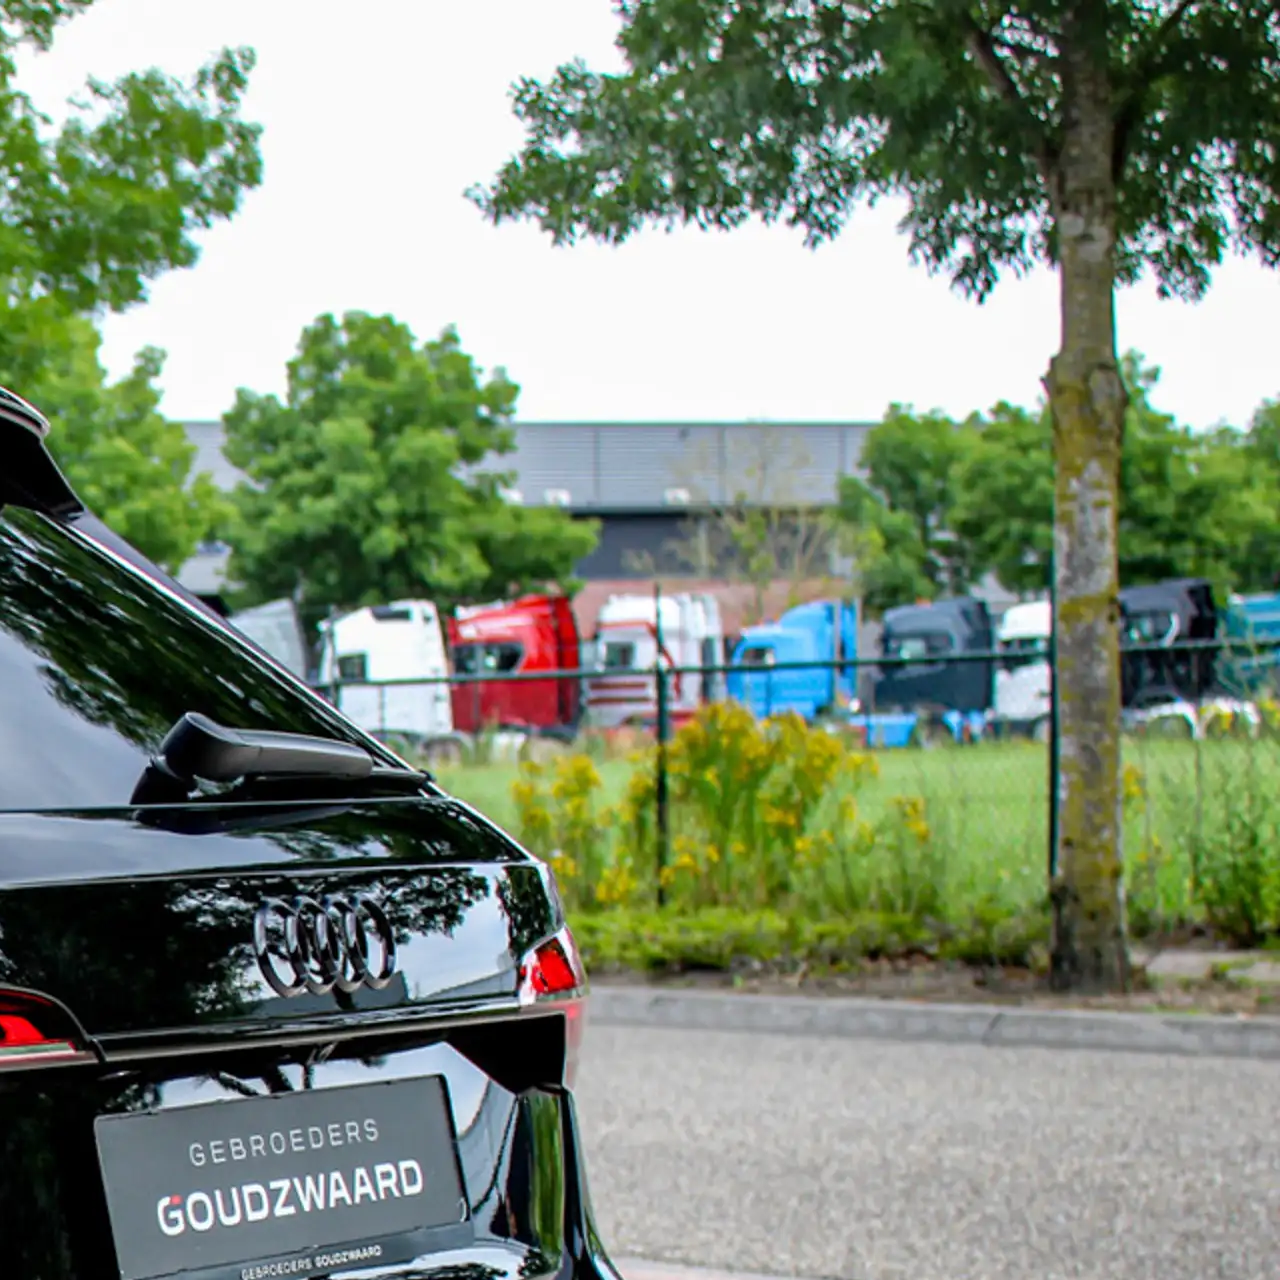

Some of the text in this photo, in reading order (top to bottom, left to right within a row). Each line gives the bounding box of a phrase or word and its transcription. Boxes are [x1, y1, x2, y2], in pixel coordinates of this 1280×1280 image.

[188, 1118, 380, 1167] GEBROEDERS
[156, 1158, 425, 1237] GOUDZWAARD
[315, 1244, 383, 1268] GOUDZWAARD
